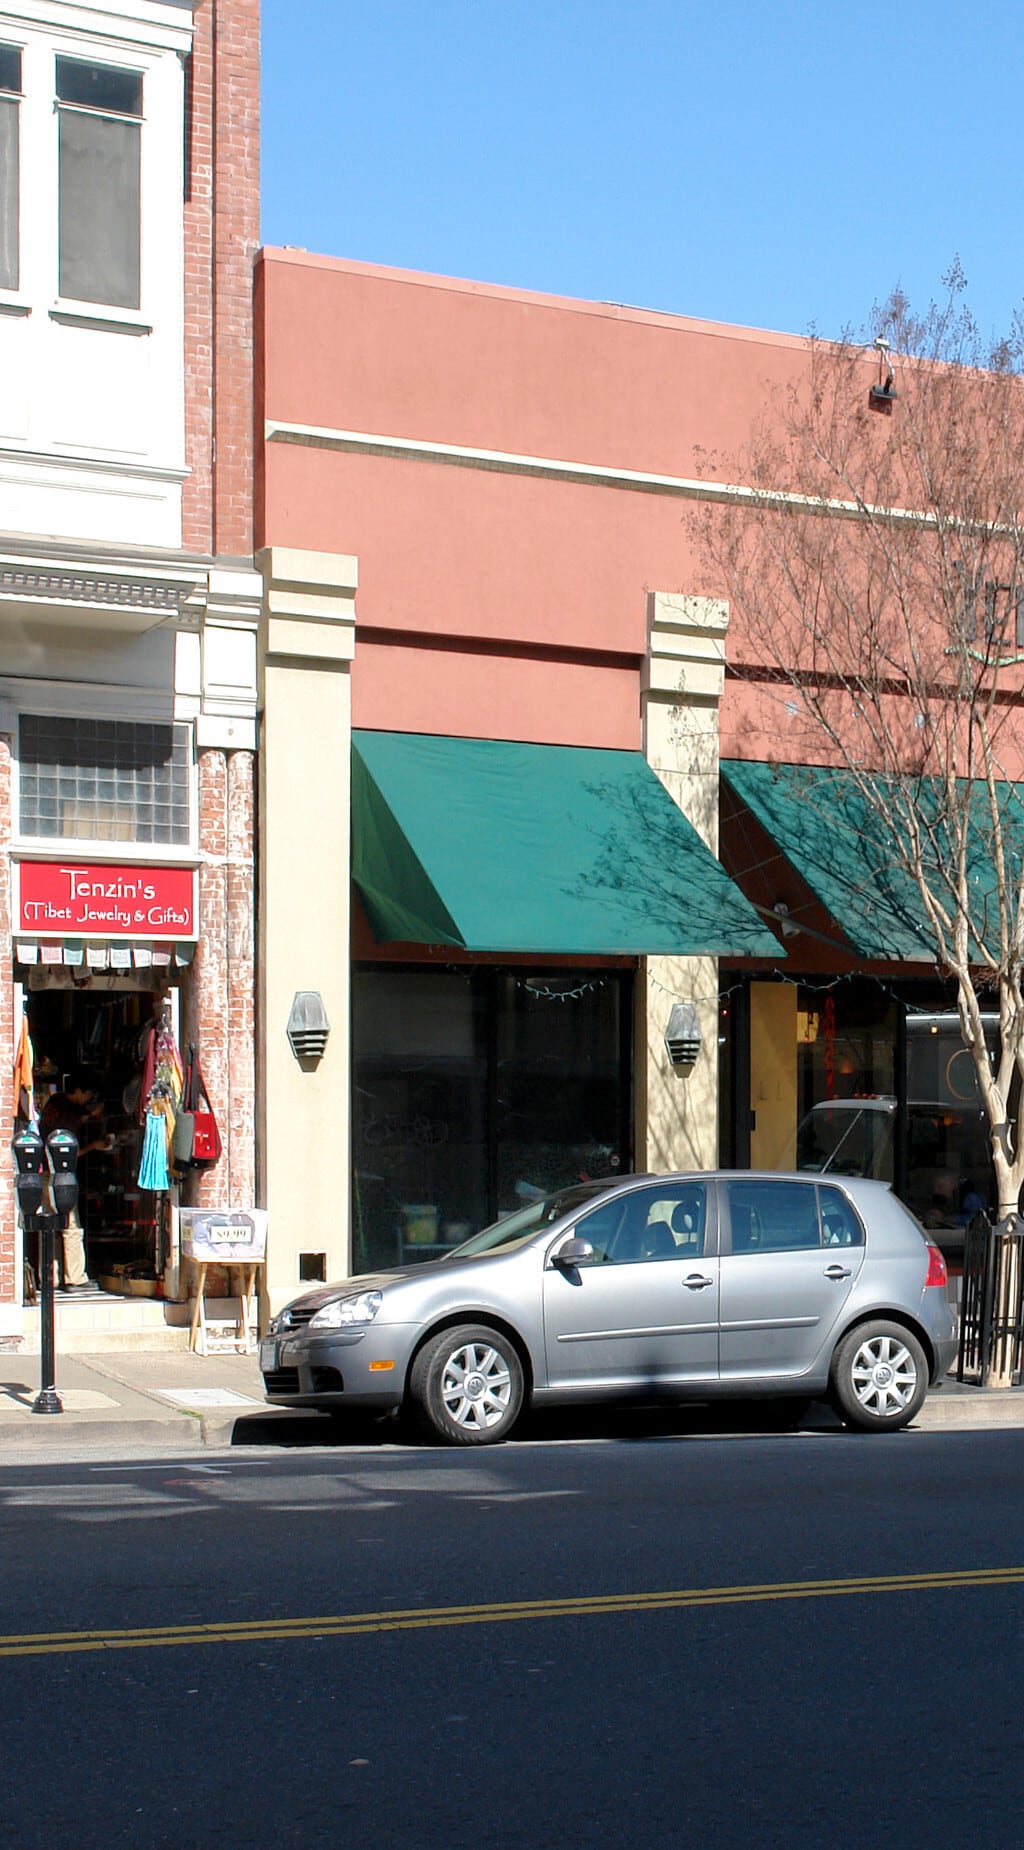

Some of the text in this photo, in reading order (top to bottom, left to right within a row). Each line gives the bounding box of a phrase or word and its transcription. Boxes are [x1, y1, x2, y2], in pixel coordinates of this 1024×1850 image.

[60, 868, 156, 900] Tenzin's
[24, 901, 190, 927] (Tibet Jewelry & Gifts)
